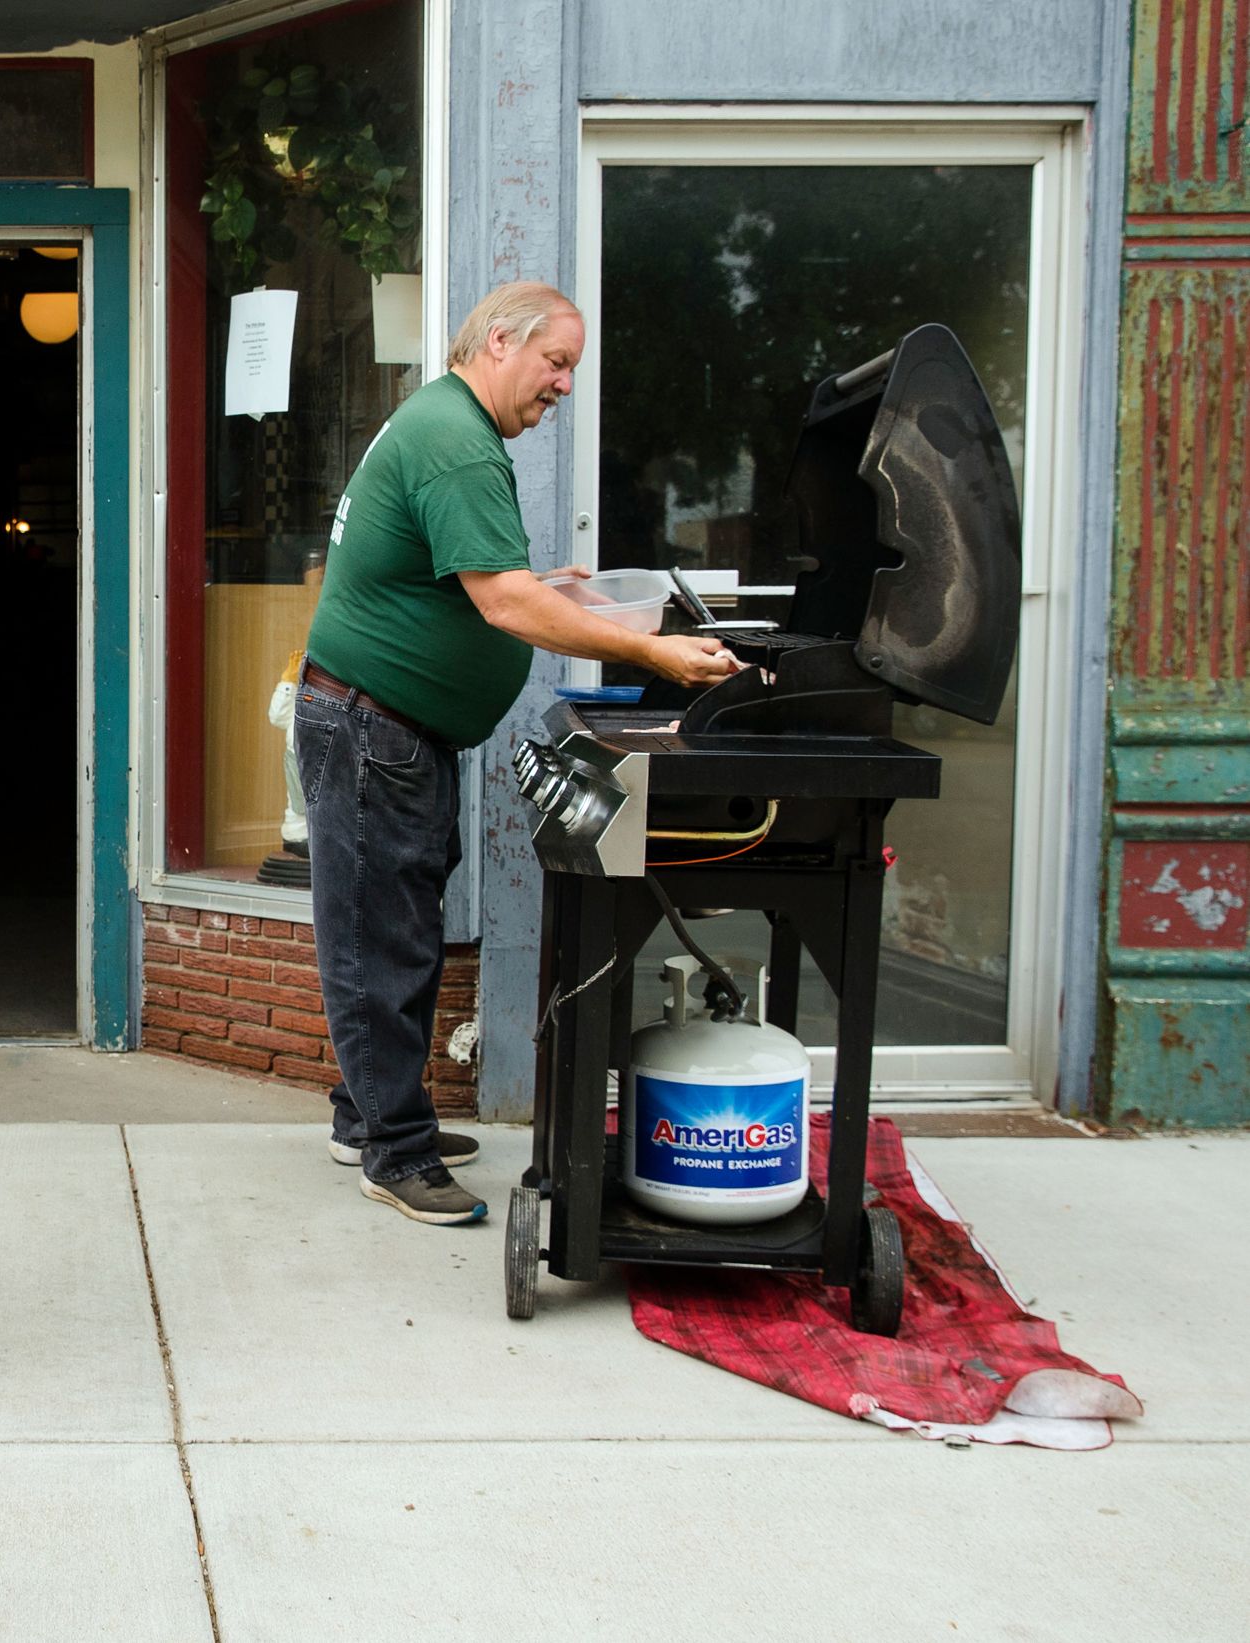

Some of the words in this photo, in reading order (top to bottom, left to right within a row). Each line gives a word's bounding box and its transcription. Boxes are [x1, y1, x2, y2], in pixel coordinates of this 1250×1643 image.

[652, 1118, 793, 1148] AmeriGas
[673, 1156, 723, 1170] PROPANE
[728, 1157, 782, 1170] EXCHANGE
